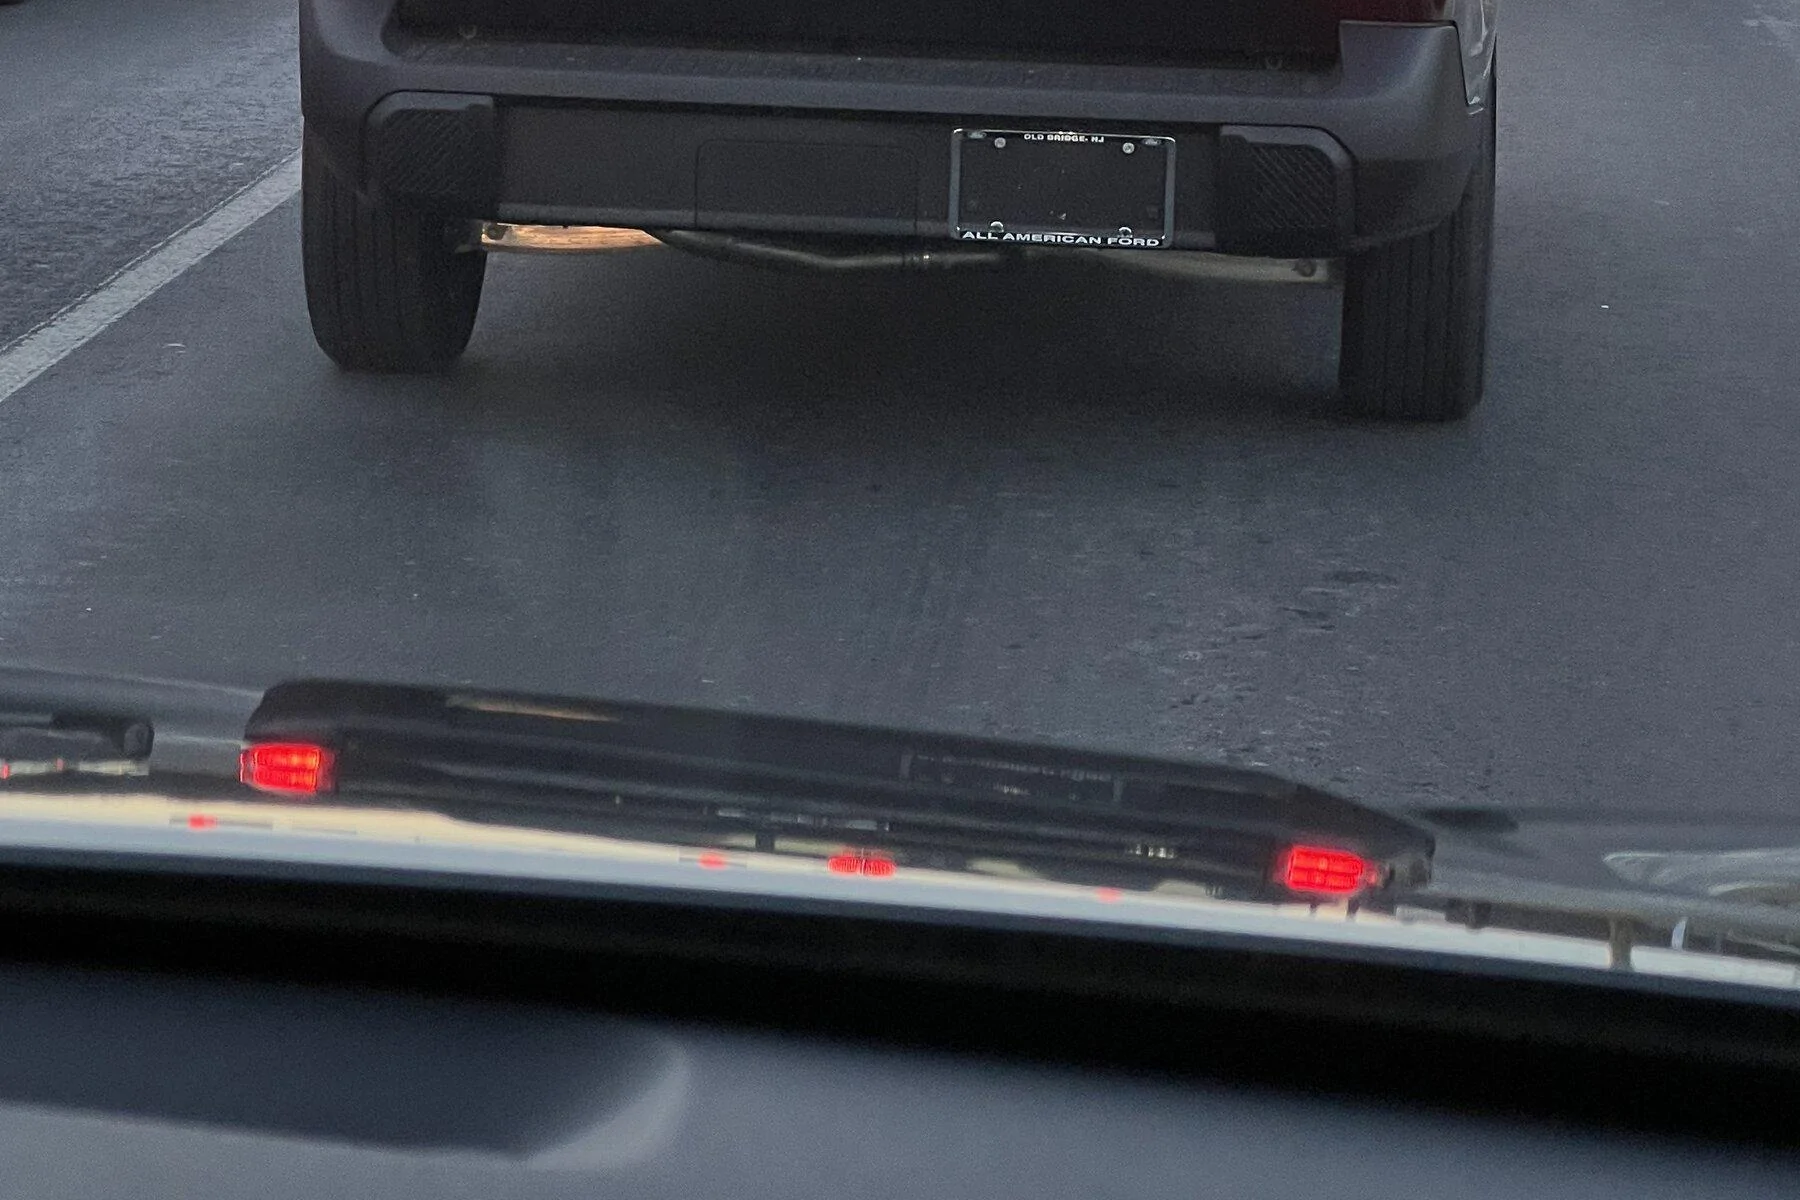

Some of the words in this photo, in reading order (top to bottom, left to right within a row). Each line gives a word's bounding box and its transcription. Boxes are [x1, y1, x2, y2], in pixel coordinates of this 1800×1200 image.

[1023, 133, 1044, 141] OLD
[962, 231, 998, 240] ALL
[1002, 232, 1102, 245] AMERICAN
[1107, 237, 1160, 247] FORD
